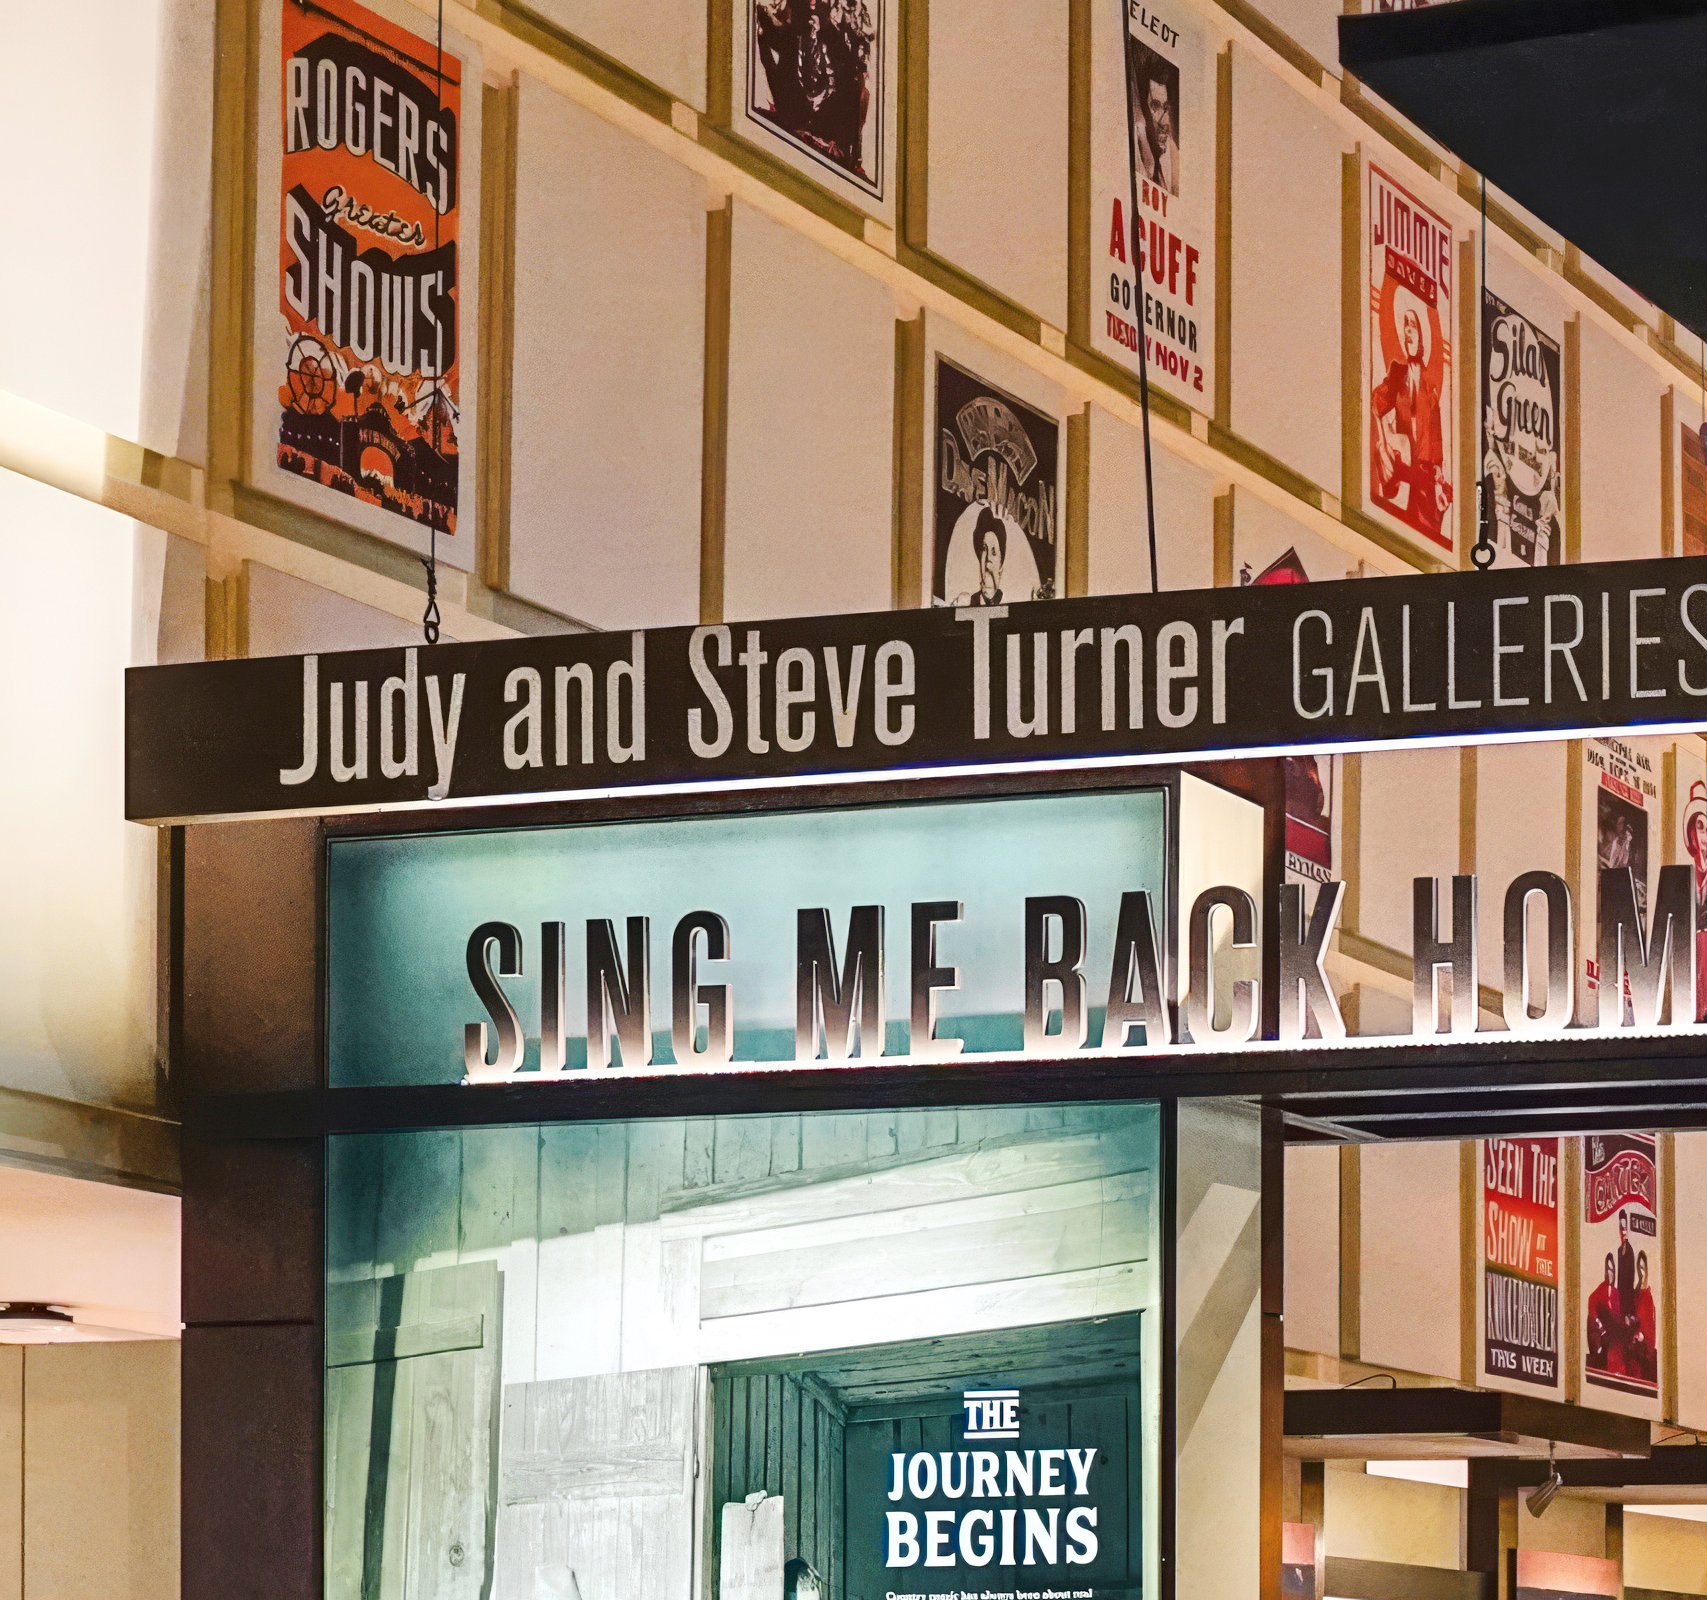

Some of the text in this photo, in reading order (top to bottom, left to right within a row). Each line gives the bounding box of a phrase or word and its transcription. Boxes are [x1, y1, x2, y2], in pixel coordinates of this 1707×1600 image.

[286, 56, 449, 216] ROGERS
[1142, 179, 1168, 218] ROY
[1109, 197, 1200, 307] ACUFF
[1374, 184, 1449, 300] JIMMIE
[285, 191, 444, 379] SHOWS
[1110, 272, 1197, 353] GOERNOR
[1155, 340, 1190, 383] NOV
[1193, 364, 1204, 392] 2
[1493, 380, 1552, 447] Green
[279, 647, 467, 802] Judy
[502, 628, 647, 771] and
[687, 623, 917, 760] Steve
[954, 603, 1245, 741] Turner
[463, 908, 737, 1081] SING
[795, 899, 965, 1064] ME
[1022, 876, 1347, 1054] BACK
[1485, 1139, 1556, 1209] SEEN THE
[1486, 1200, 1534, 1272] SHOW
[1521, 1354, 1554, 1378] WEEK
[964, 1398, 1020, 1431] THE
[886, 1447, 1098, 1502] JOURNEY
[884, 1505, 1099, 1568] BEGINS
